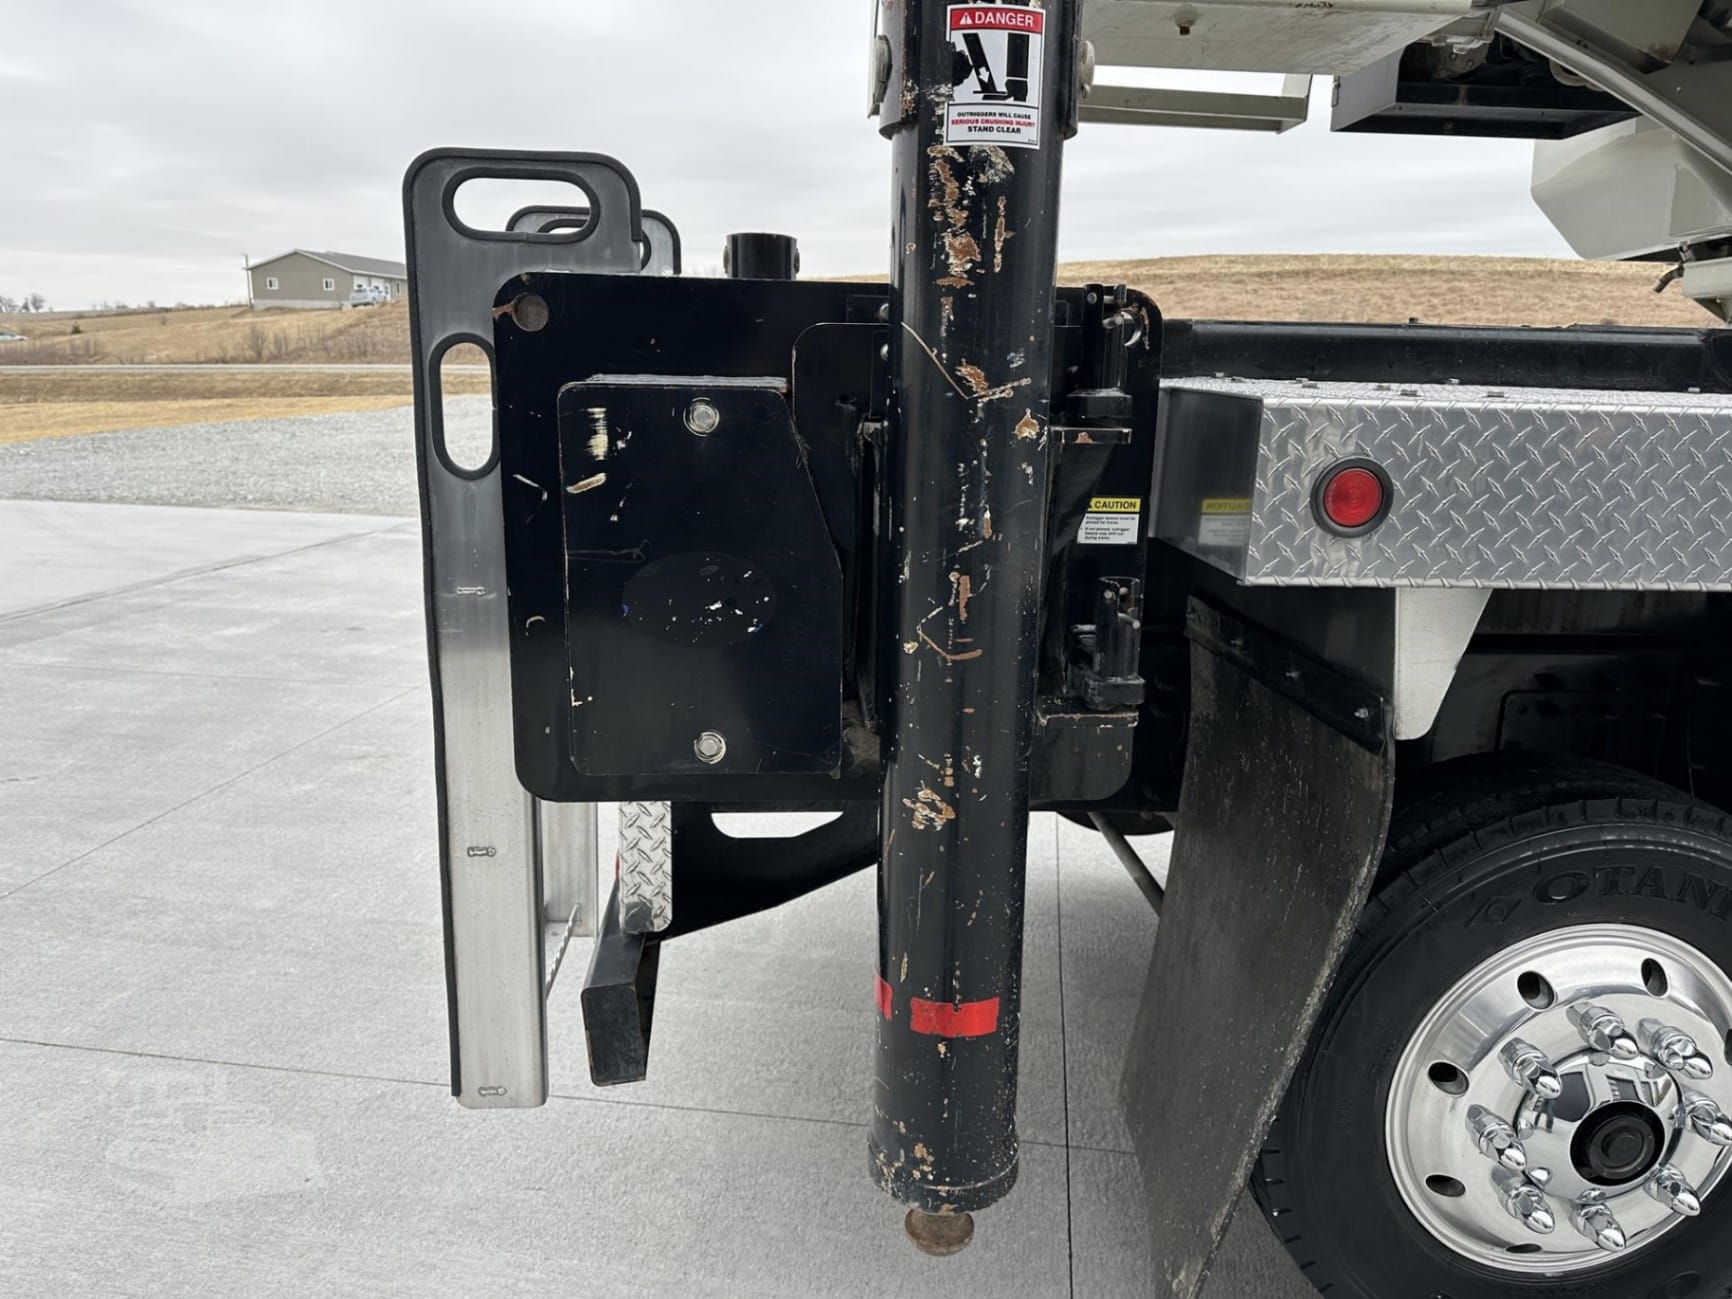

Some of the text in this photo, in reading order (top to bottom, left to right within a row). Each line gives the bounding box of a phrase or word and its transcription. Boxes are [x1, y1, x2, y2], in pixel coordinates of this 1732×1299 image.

[975, 11, 1034, 27] DANGER
[1013, 112, 1031, 120] CAUSE
[980, 118, 1014, 126] CRUSHING
[1015, 120, 1036, 128] INJURY
[967, 125, 1021, 134] STAND CLEAR
[1094, 500, 1137, 509] CAUTION
